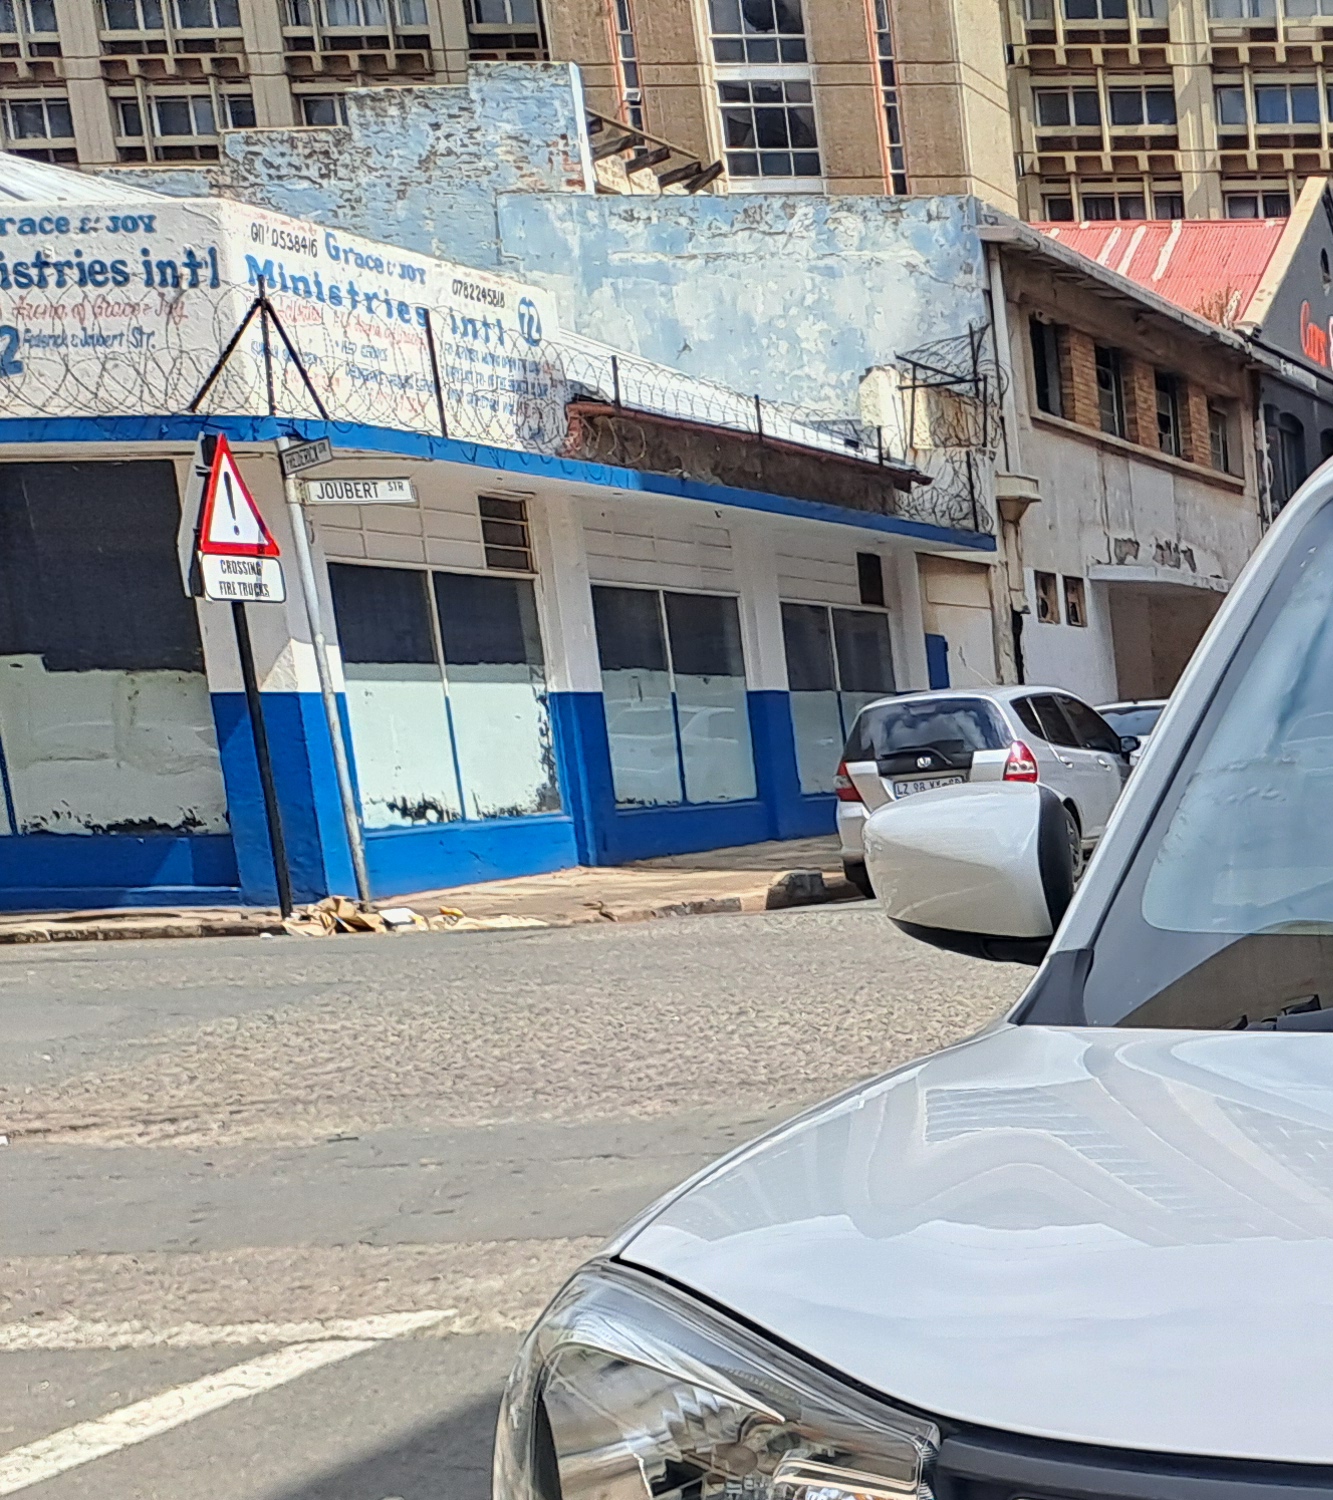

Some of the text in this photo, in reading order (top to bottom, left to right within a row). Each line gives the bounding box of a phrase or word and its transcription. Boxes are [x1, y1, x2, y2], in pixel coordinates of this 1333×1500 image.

[105, 214, 157, 234] JOY
[325, 232, 384, 275] Grace
[245, 253, 428, 328] Ministries
[316, 481, 405, 500] JOUBERT STR
[220, 559, 264, 576] CROSSING
[218, 580, 270, 598] FIRE TRUCKS
